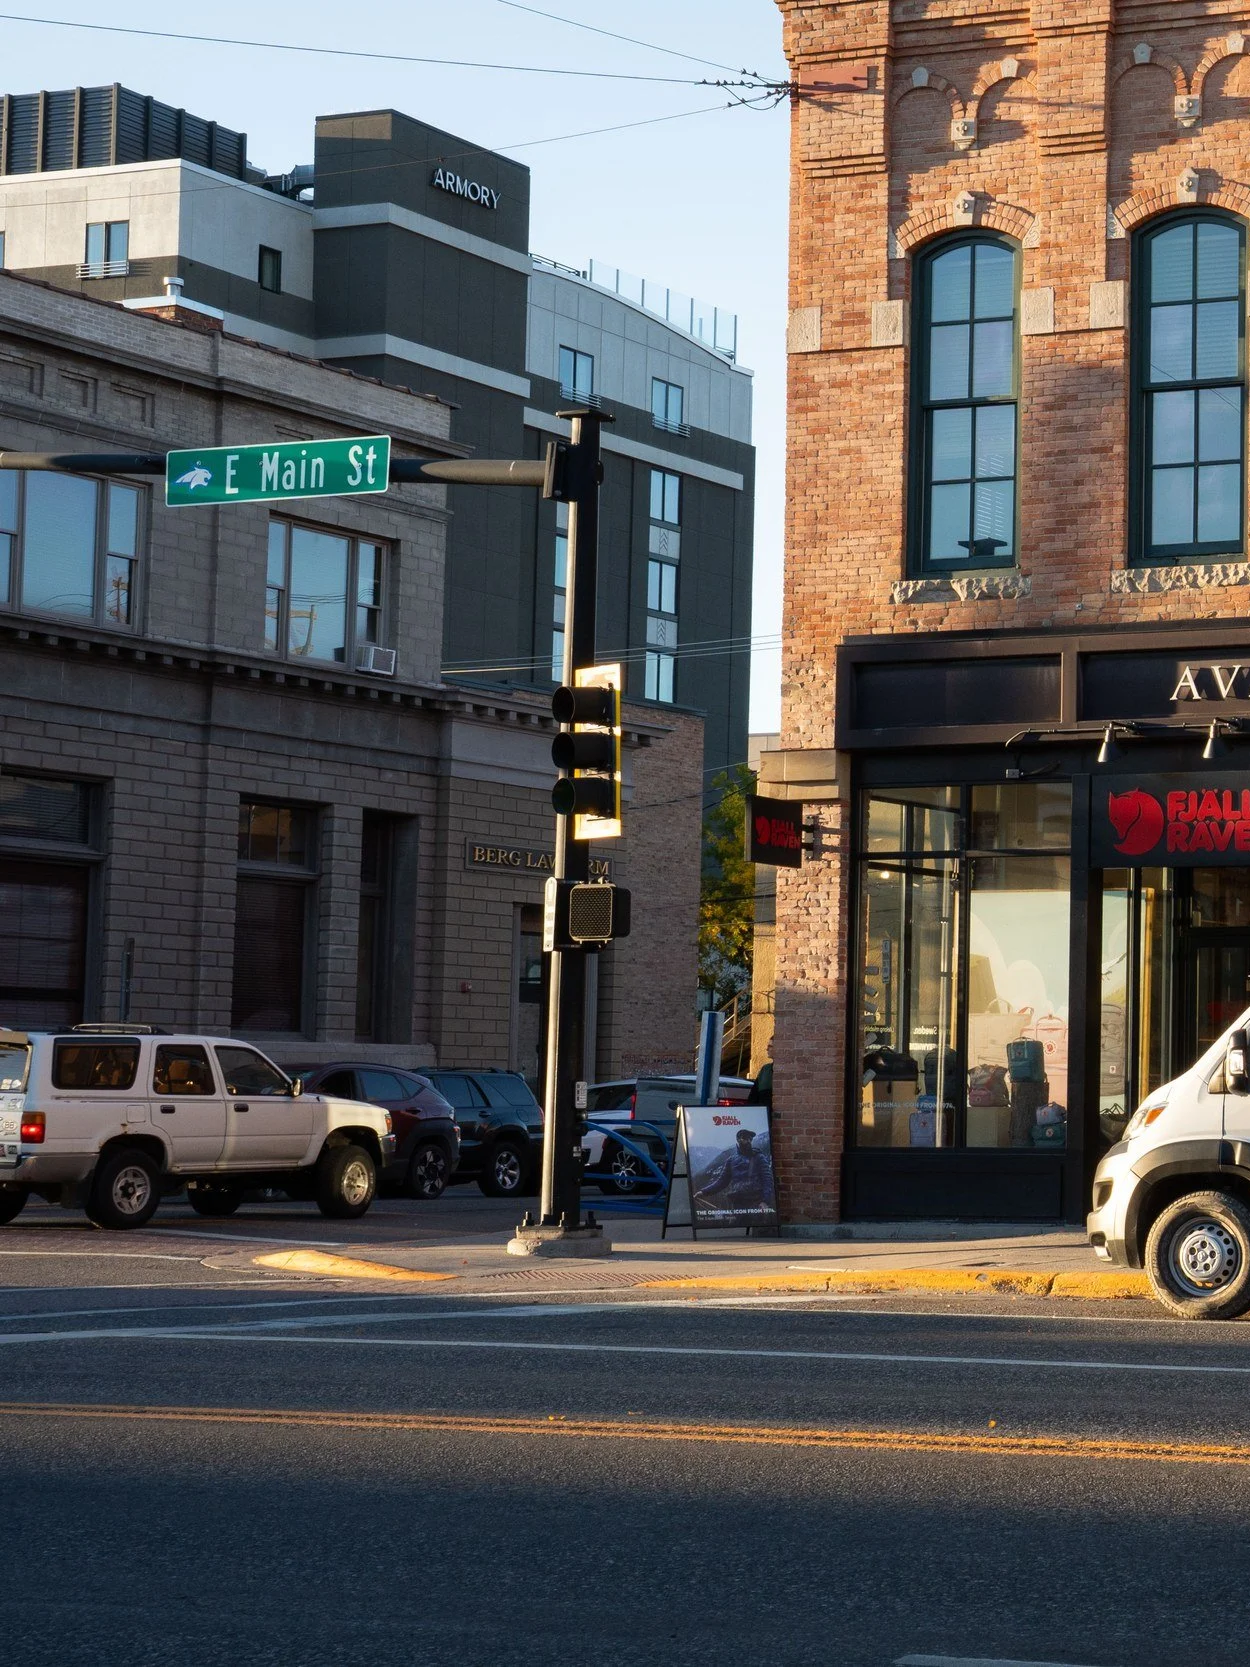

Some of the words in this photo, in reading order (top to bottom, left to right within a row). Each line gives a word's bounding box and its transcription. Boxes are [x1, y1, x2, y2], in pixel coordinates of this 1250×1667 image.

[434, 168, 501, 209] ARMORY
[225, 454, 239, 494] E
[261, 450, 325, 492] Main
[347, 445, 377, 486] St
[474, 846, 521, 866] BERG
[588, 859, 610, 875] RM
